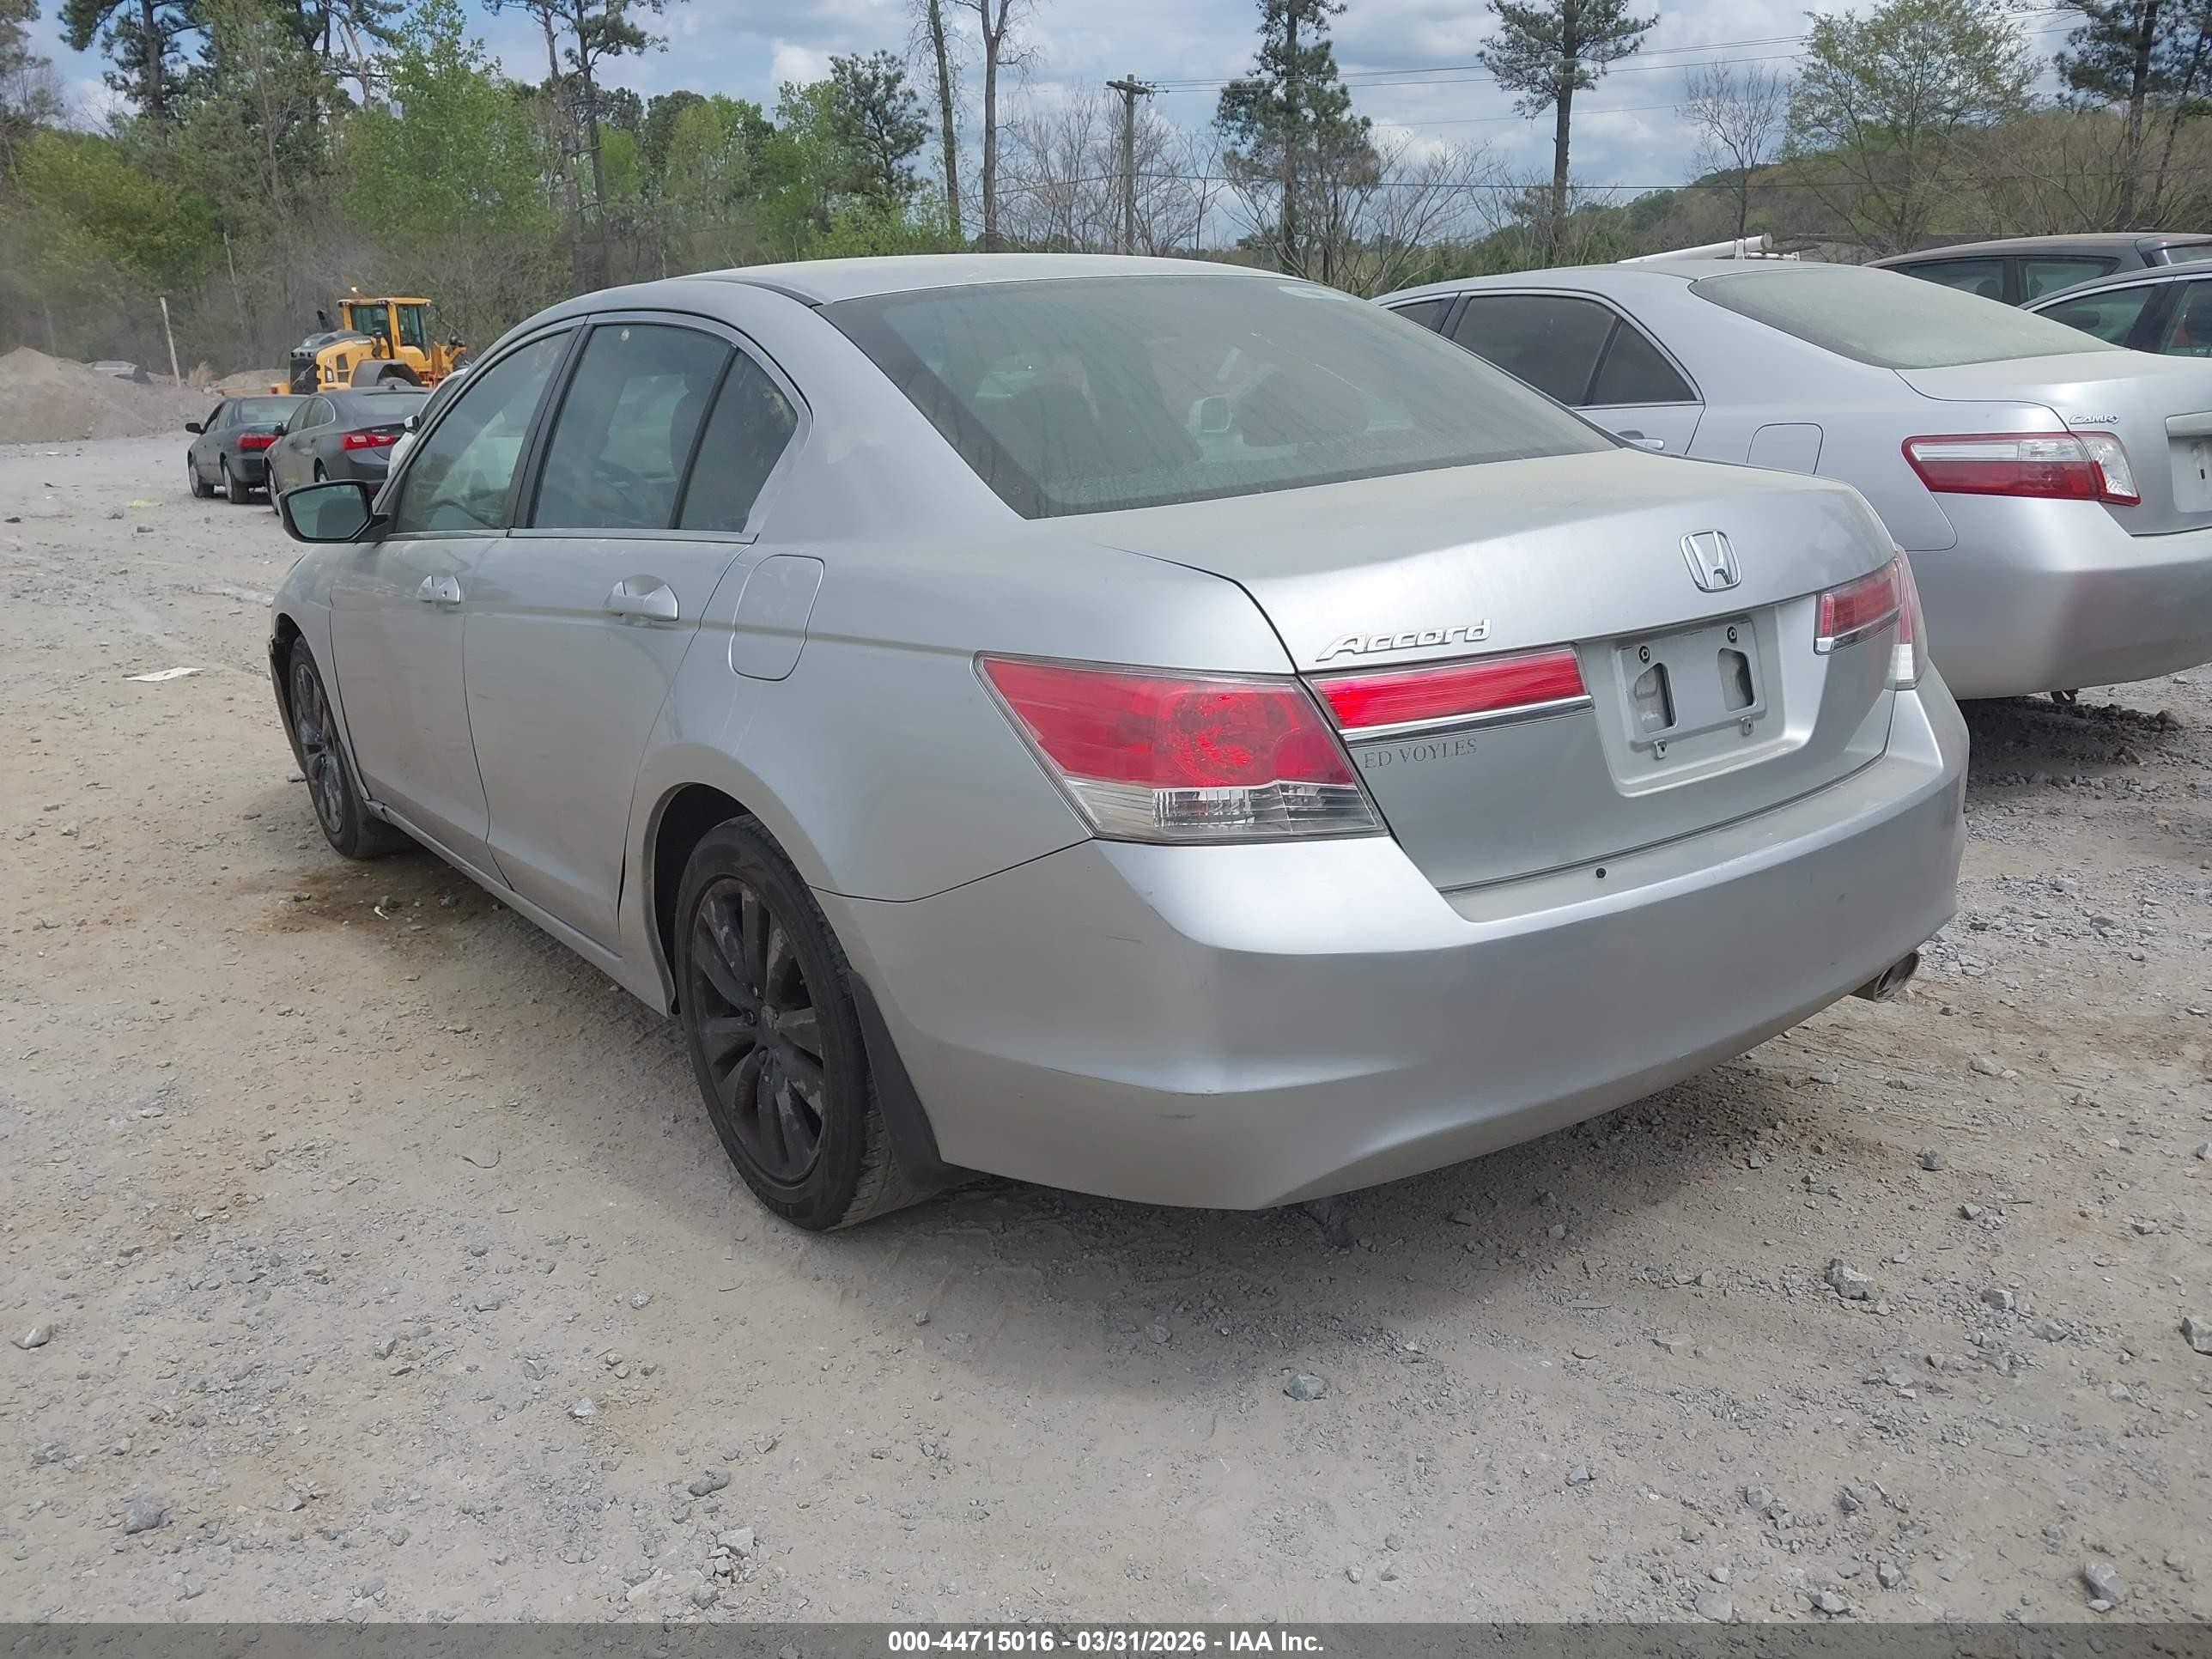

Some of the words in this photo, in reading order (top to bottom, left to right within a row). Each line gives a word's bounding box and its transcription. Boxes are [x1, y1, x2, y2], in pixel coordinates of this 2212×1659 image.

[1316, 618, 1492, 662] Accord
[1364, 750, 1392, 769] ED
[1397, 739, 1477, 763] VOYLES
